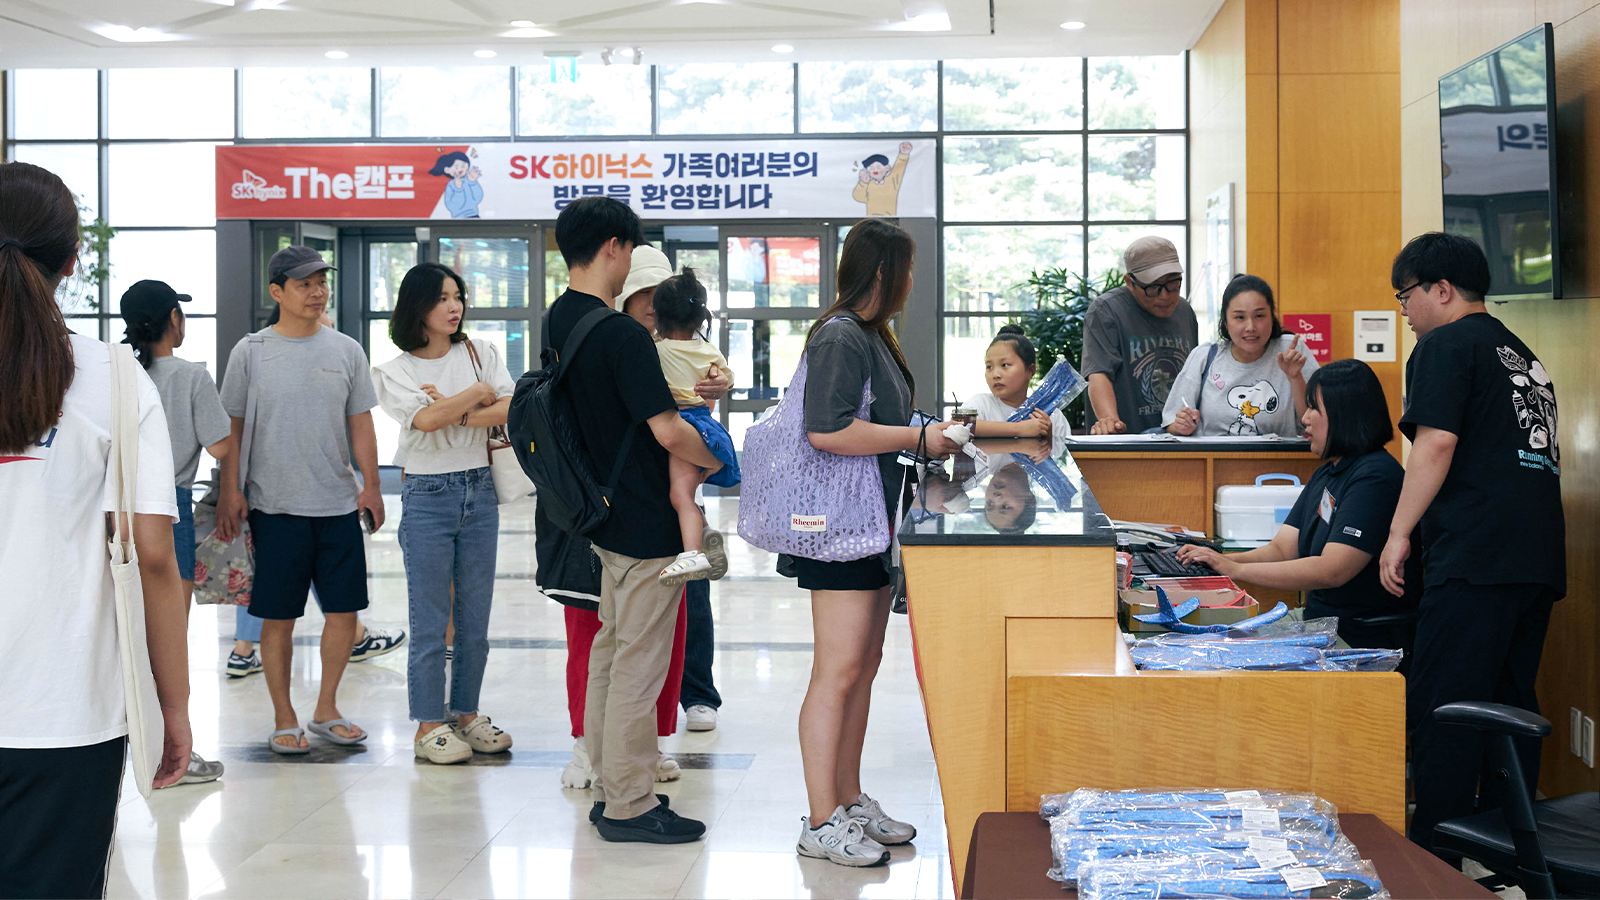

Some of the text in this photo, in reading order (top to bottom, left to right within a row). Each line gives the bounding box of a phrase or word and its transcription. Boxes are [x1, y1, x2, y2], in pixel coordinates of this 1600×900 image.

[509, 152, 818, 179] SK하이닉스 가족여러분의
[233, 184, 251, 198] SK
[284, 166, 415, 199] The캠프
[641, 183, 773, 210] 환영합니다
[1518, 449, 1545, 466] Running
